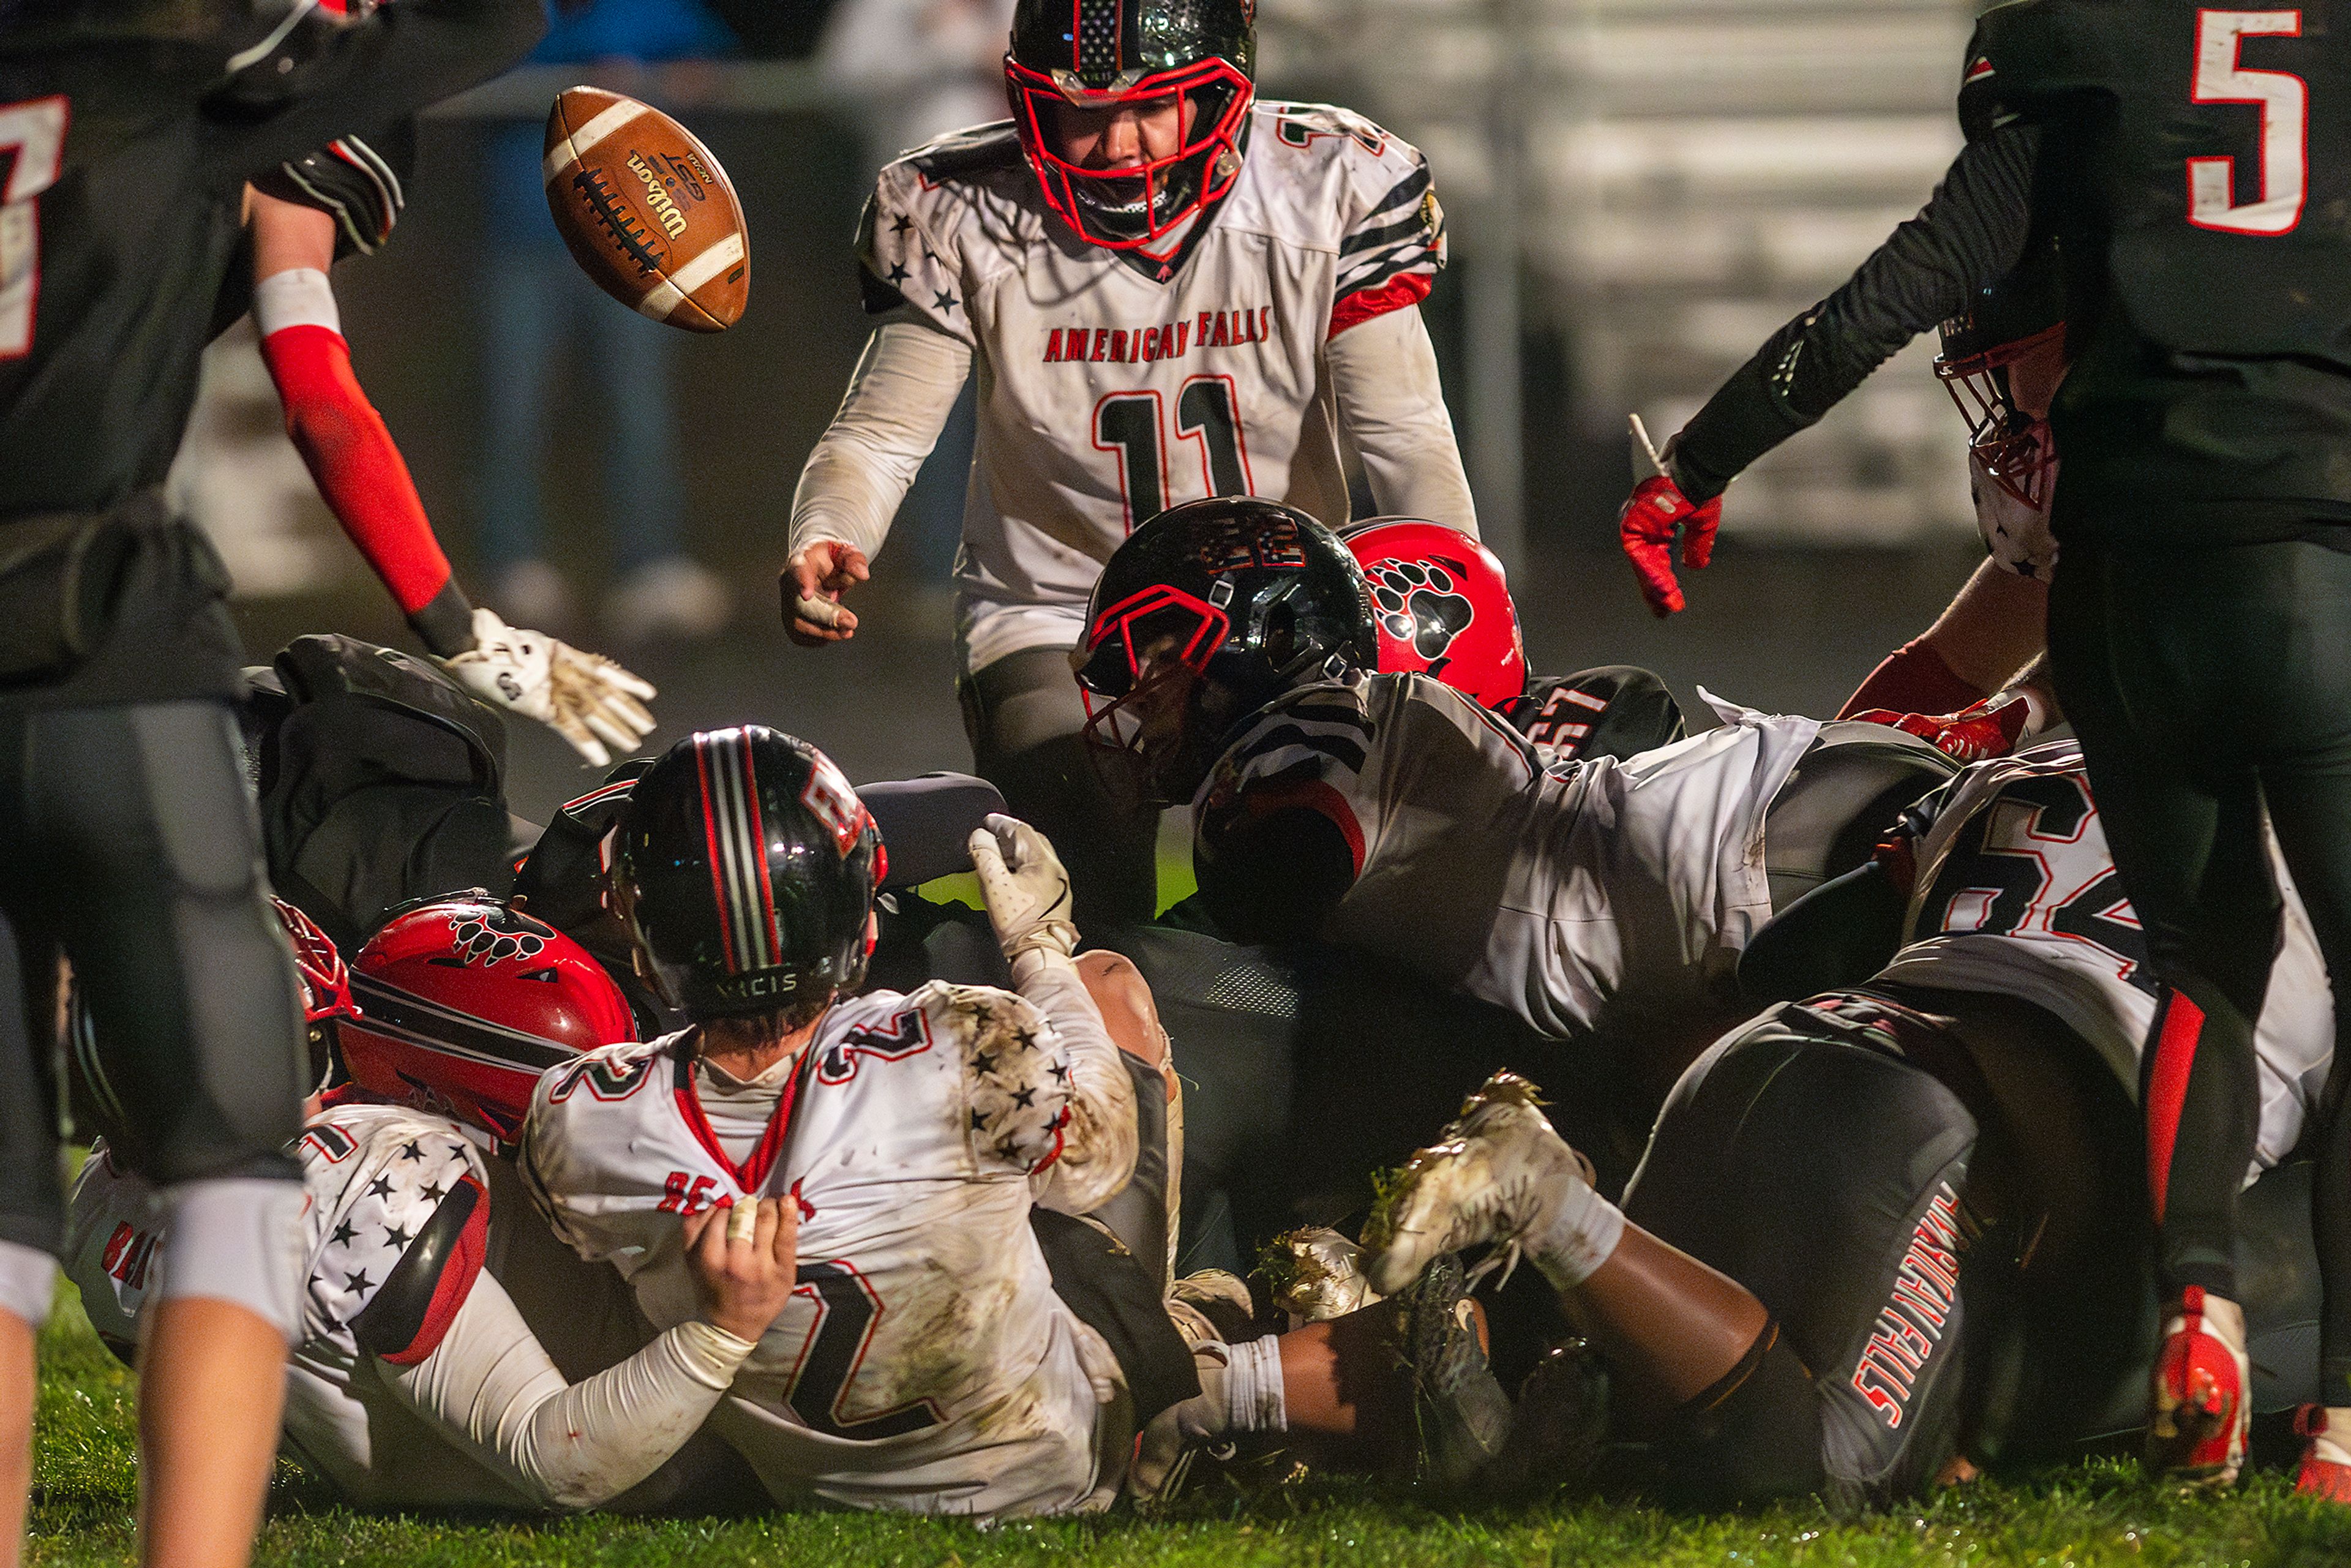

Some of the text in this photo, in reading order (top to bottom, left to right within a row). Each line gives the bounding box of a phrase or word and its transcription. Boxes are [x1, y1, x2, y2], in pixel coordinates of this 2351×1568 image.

[2186, 8, 2309, 236] 5
[625, 152, 688, 240] Wilson
[660, 152, 705, 201] GST
[1043, 306, 1272, 363] AMERICAN FALLS
[1092, 373, 1255, 539] 11
[1850, 1305, 1936, 1430] FALLS
